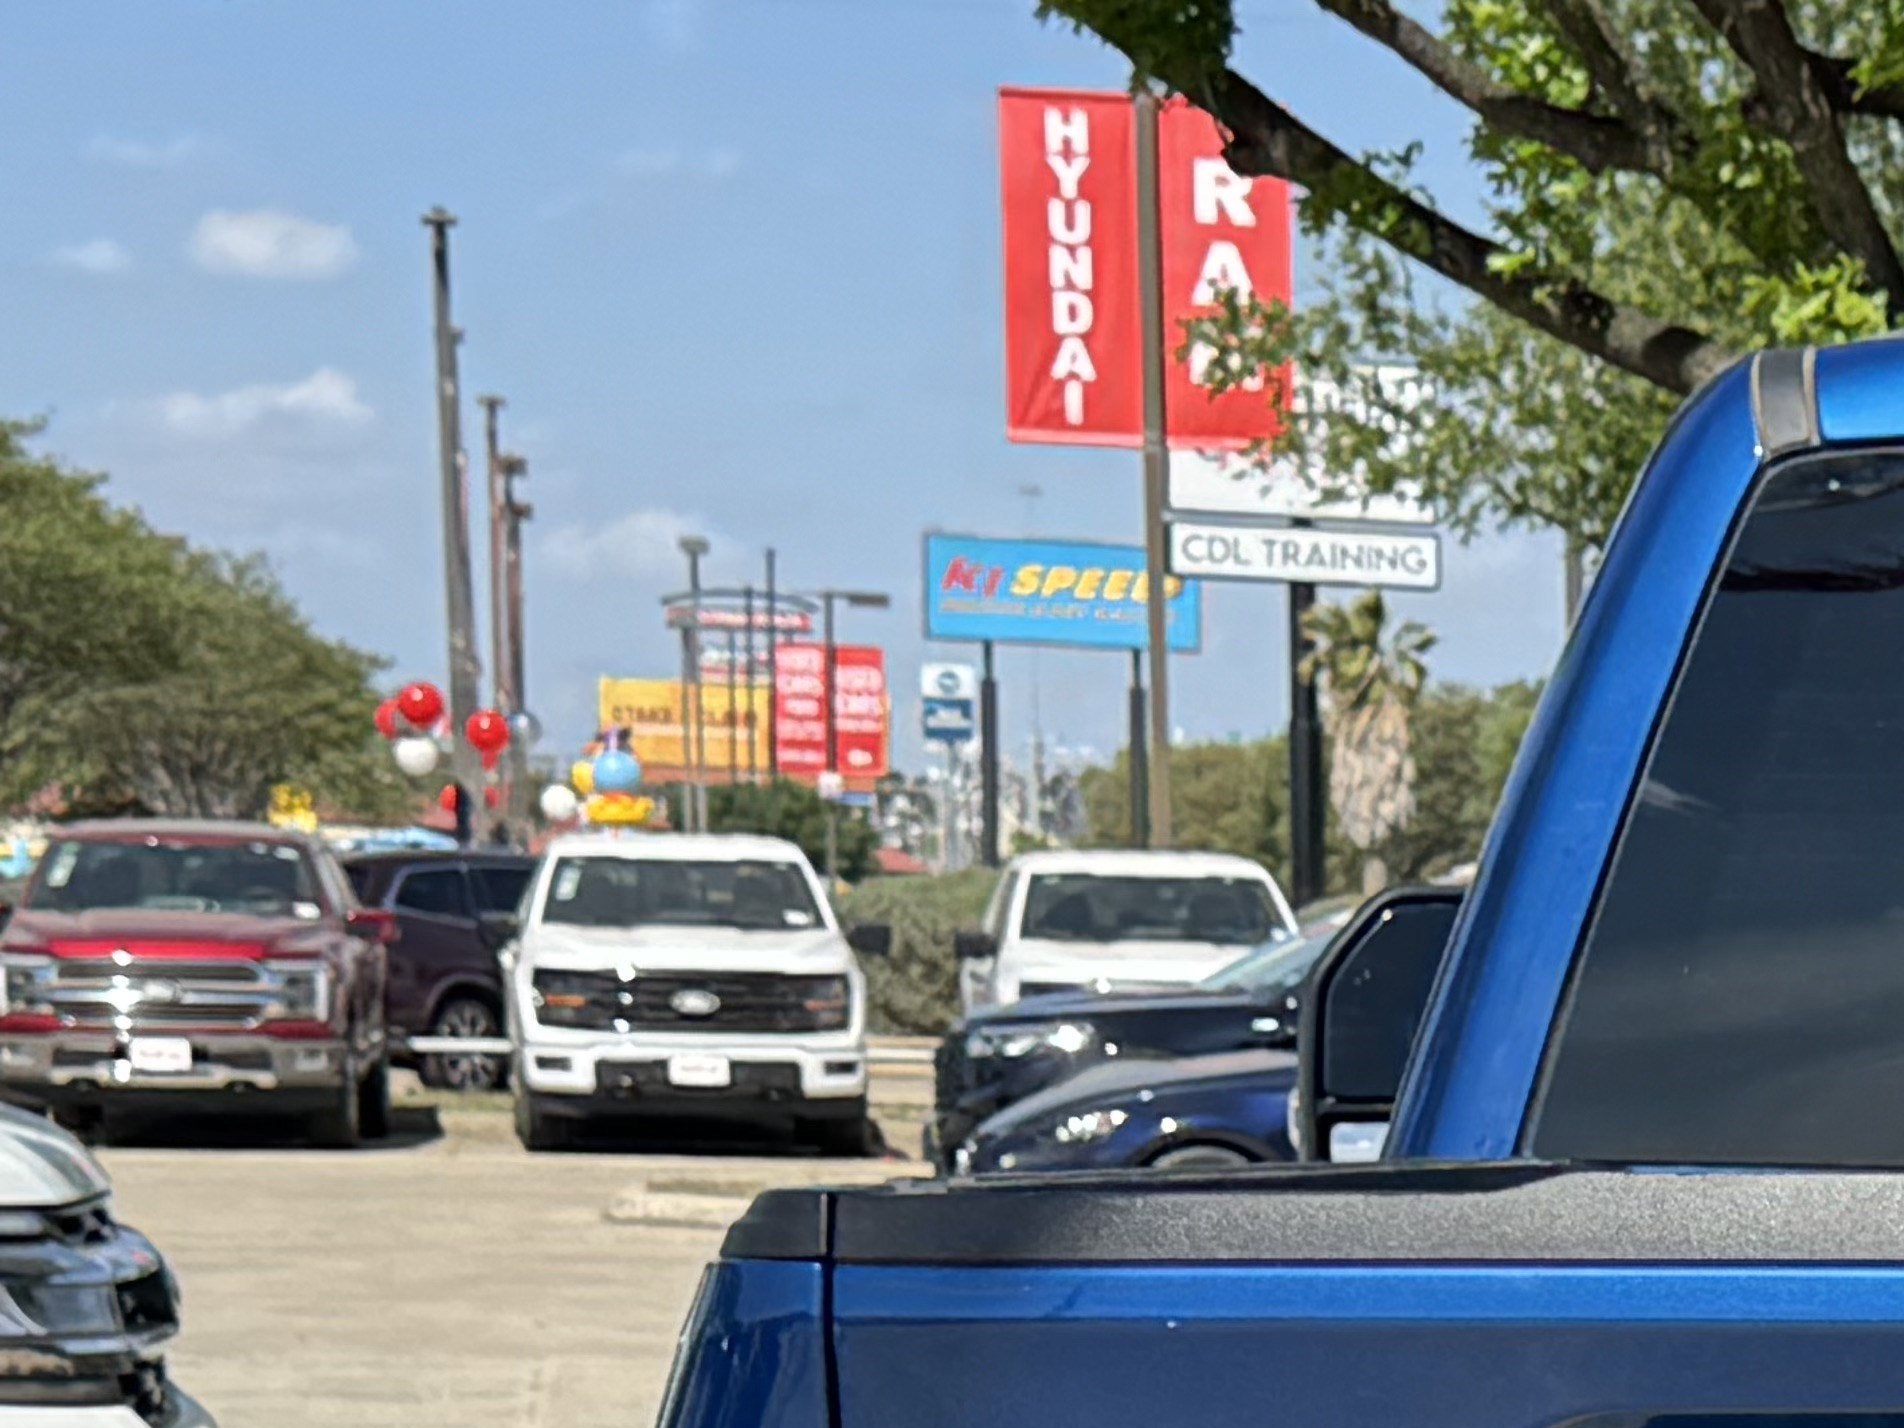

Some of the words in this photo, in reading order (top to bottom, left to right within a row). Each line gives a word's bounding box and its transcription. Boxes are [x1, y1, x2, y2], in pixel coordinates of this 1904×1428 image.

[1043, 106, 1097, 425] HYUNDAI
[1181, 533, 1250, 566] CDL
[1262, 538, 1428, 575] TRAINING
[1010, 564, 1184, 602] SPEED
